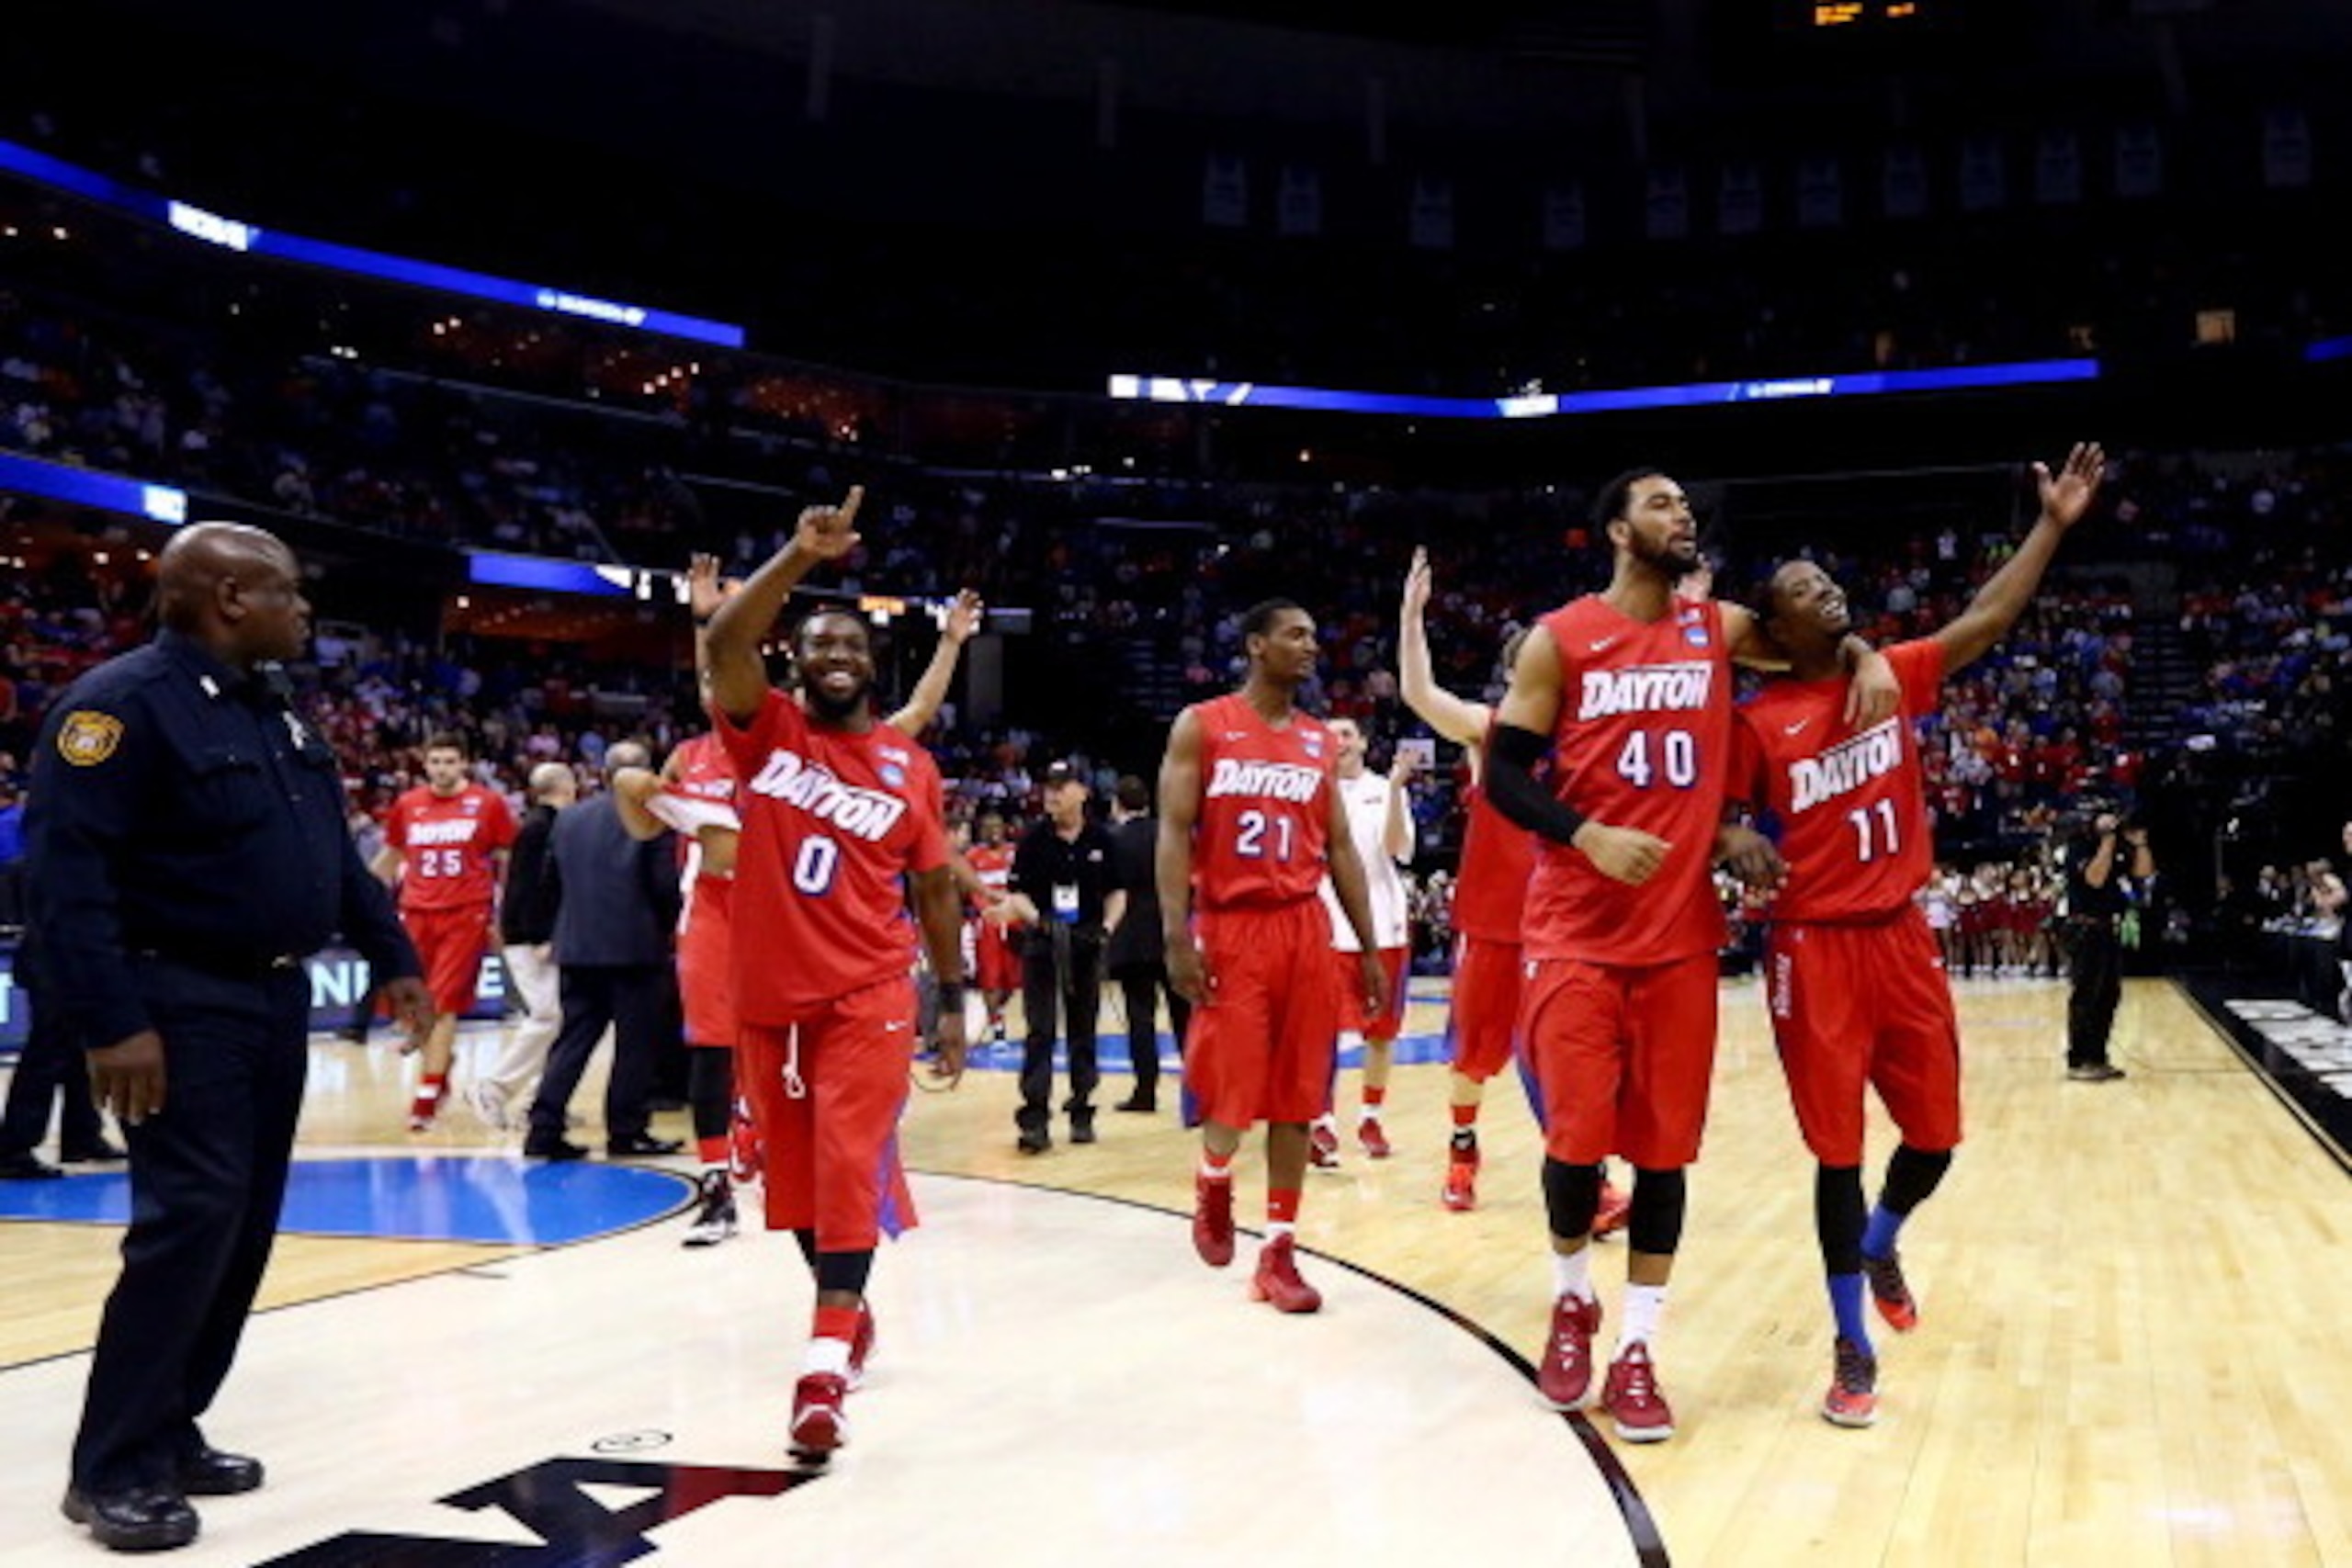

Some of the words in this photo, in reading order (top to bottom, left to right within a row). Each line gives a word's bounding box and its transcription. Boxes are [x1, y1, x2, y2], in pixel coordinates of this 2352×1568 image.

[1577, 660, 1712, 721] DAYTON
[1205, 758, 1323, 805] DAYTON
[1617, 729, 1696, 787] 40
[749, 747, 907, 842] DAYTON
[1237, 808, 1293, 862] 21
[1849, 796, 1900, 863] 11
[422, 849, 462, 877] 25
[794, 834, 838, 894] 0
